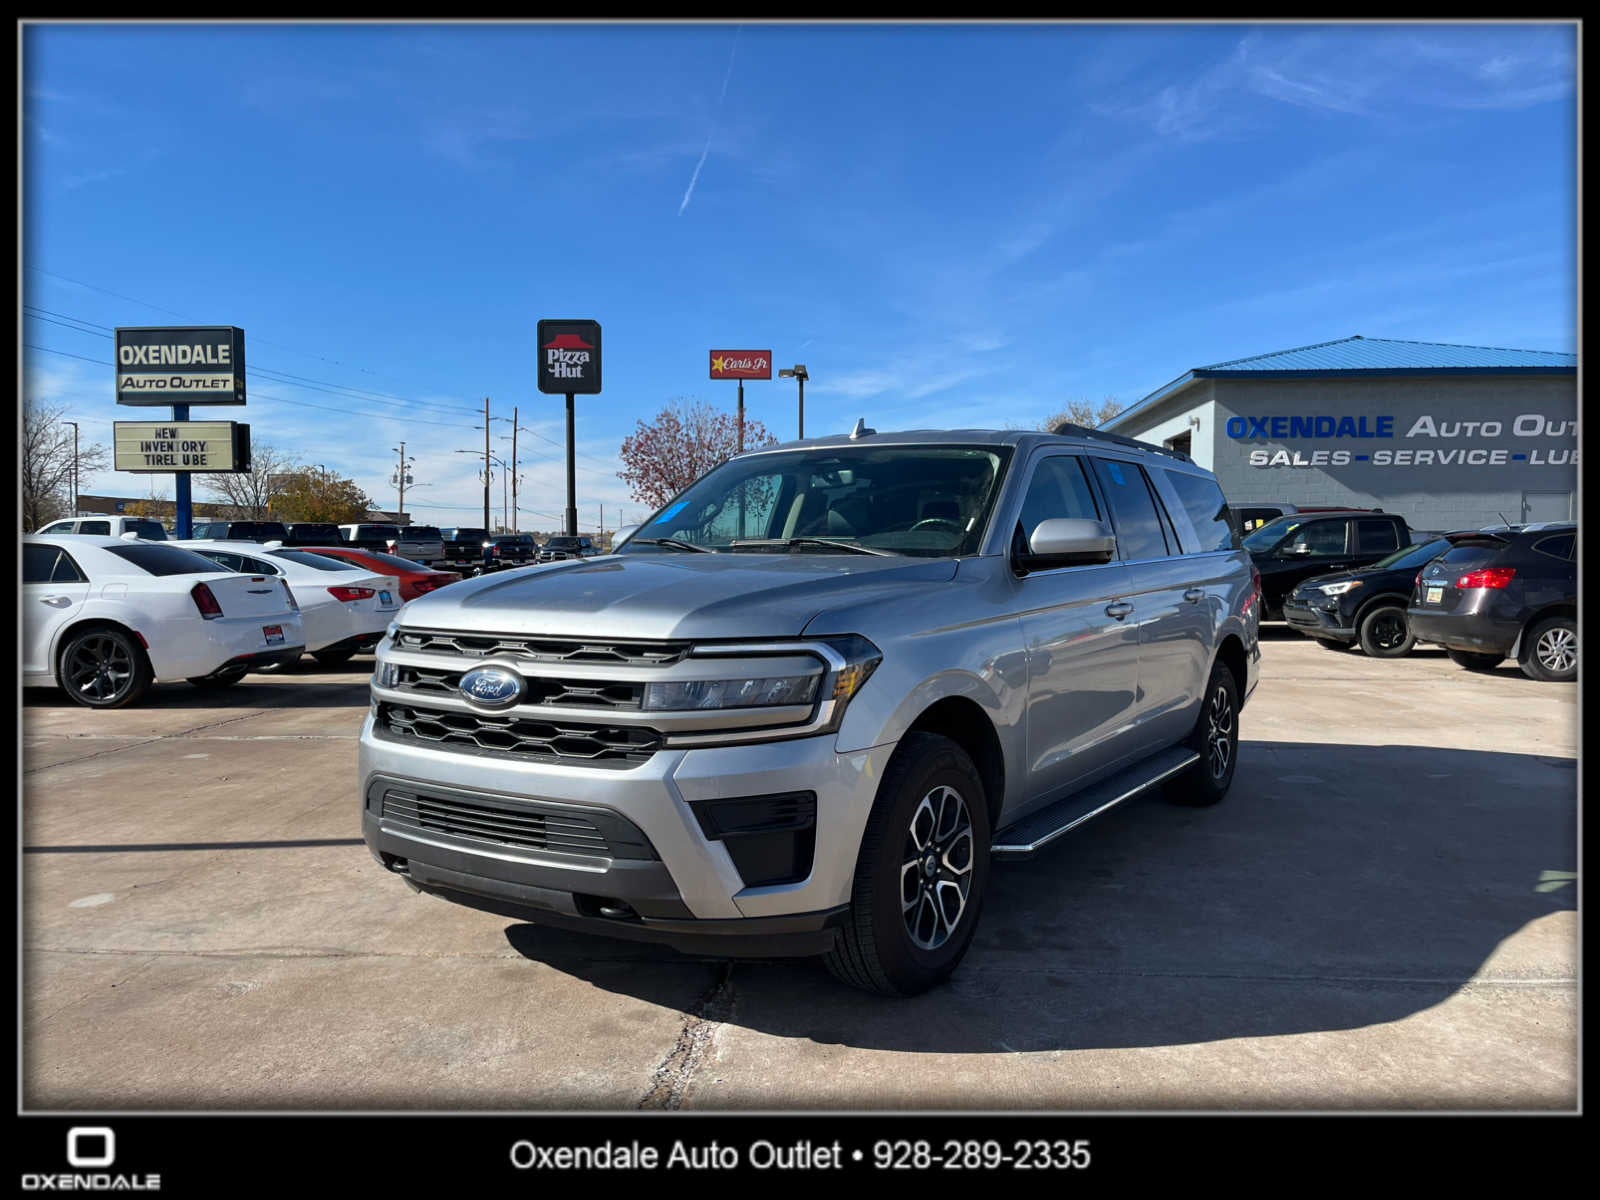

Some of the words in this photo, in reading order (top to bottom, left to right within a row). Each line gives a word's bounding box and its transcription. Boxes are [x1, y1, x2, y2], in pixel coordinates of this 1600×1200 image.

[119, 344, 231, 365] OXENDALE
[547, 348, 590, 365] Pizza
[548, 362, 584, 378] Hut
[121, 377, 167, 389] AUTO
[169, 377, 230, 388] OUTLET
[155, 427, 177, 440] NEW
[1226, 416, 1394, 439] OXENDALE
[1405, 415, 1502, 438] AUTO
[472, 678, 505, 697] Ford
